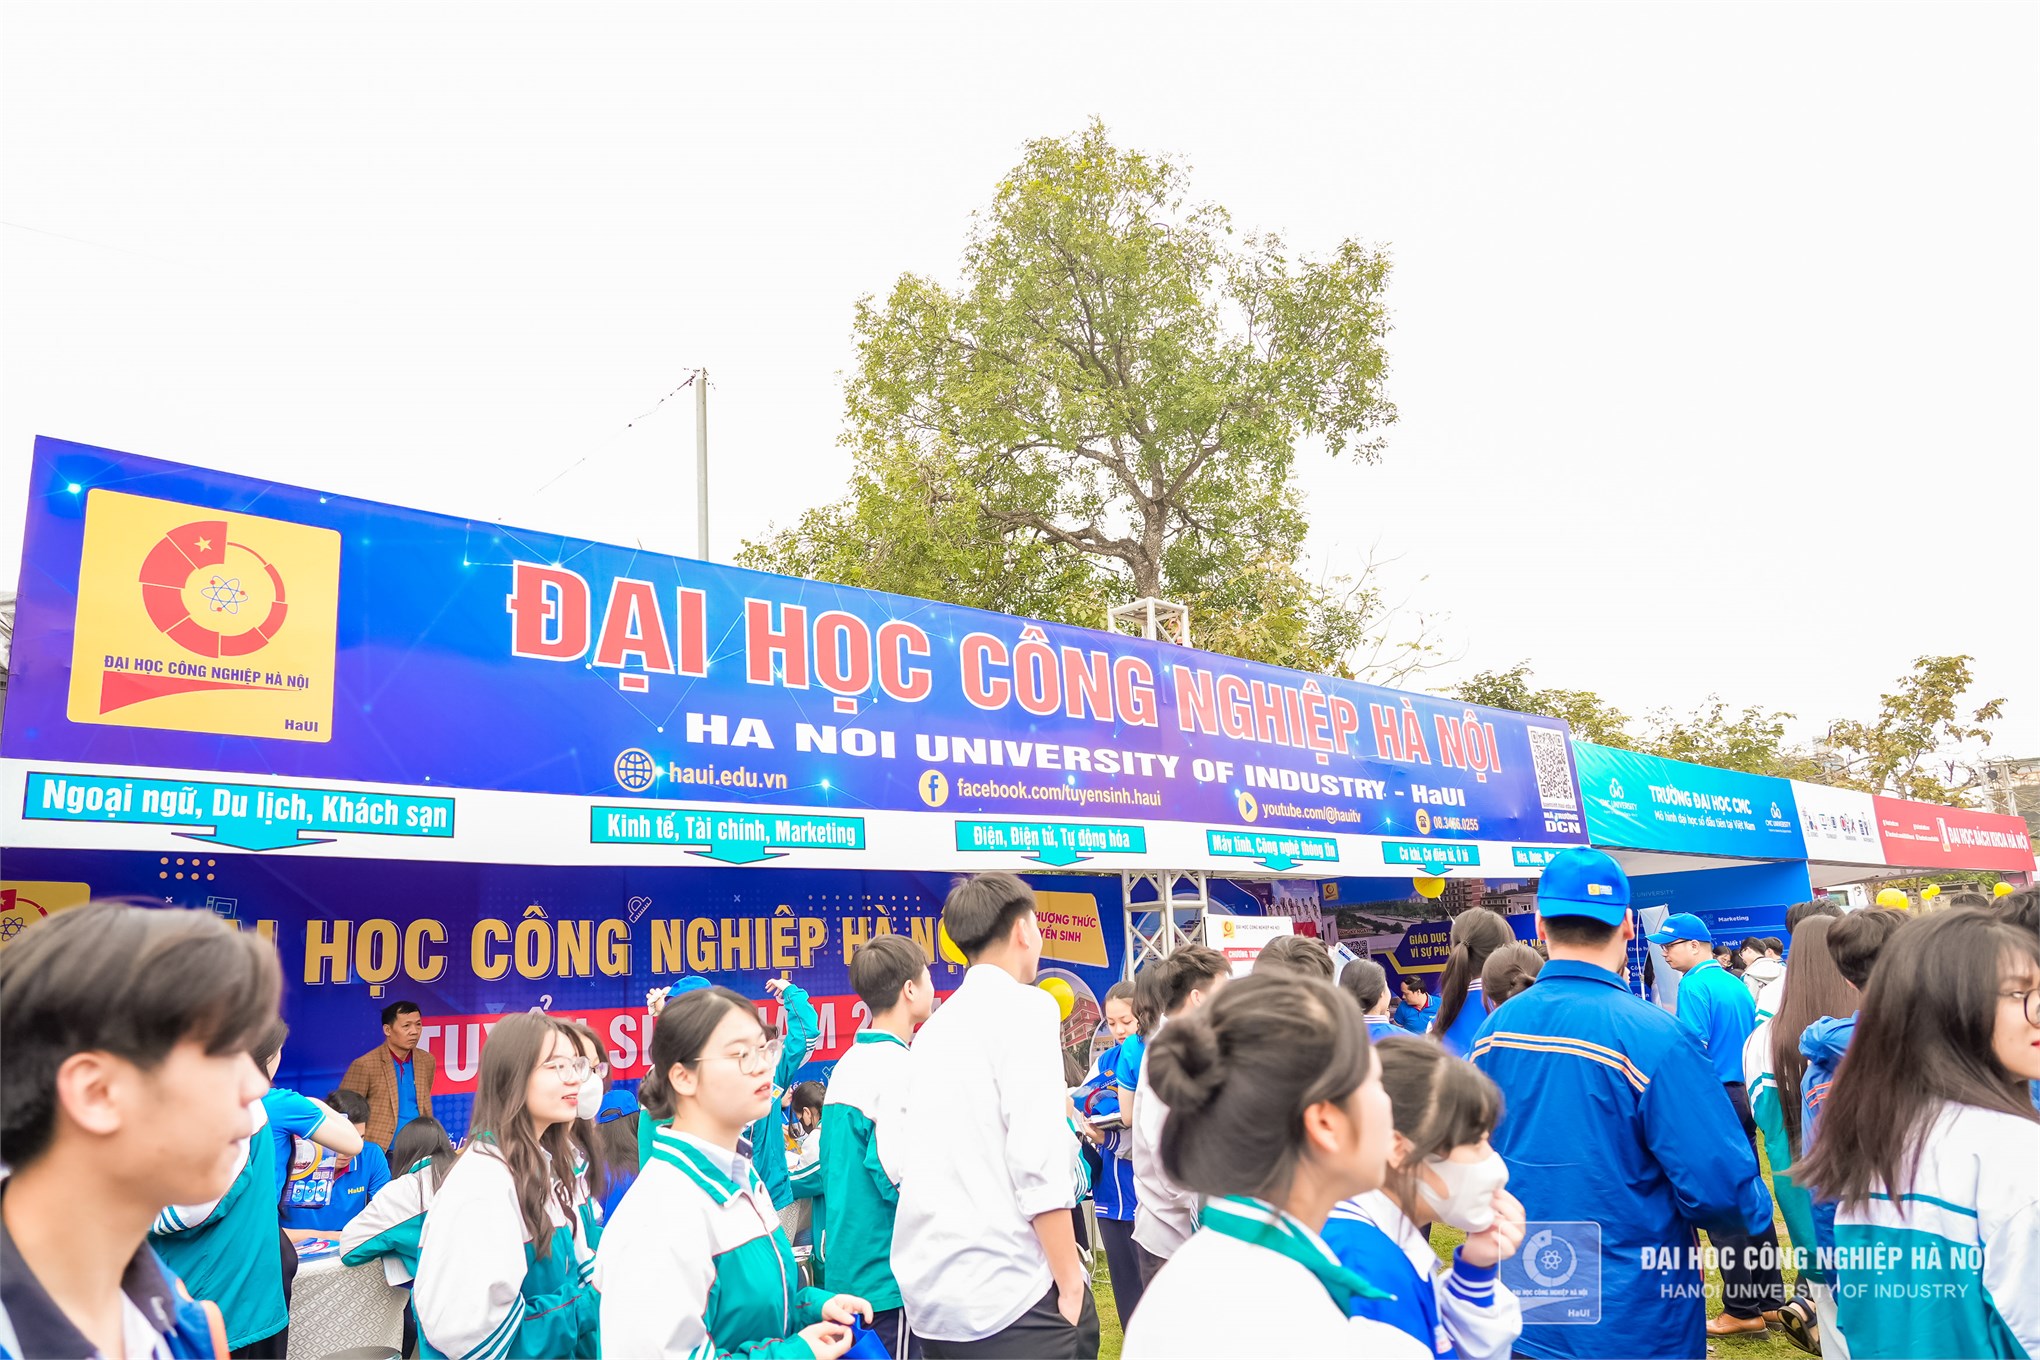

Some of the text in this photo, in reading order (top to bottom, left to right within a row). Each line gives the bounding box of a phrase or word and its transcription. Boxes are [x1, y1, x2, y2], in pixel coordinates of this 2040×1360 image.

[104, 655, 310, 691] ĐẠI HỌC CÔNG NGHIỆP HÀ NỘI
[506, 559, 1502, 783] ĐẠI HỌC CÔNG NGHIỆP HÀ NỘI
[284, 718, 319, 733] HaUI
[685, 712, 775, 750] HA
[795, 722, 896, 759] NOI
[915, 733, 1180, 779] UNIVERSITY
[1193, 758, 1234, 784] OF
[1244, 765, 1386, 800] INDUSTRY
[1411, 784, 1466, 807] HaUI
[669, 762, 788, 790] haui.edu.vn
[42, 778, 448, 833] Ngoại ngữ, Du lịch, Khách sạn
[957, 778, 1161, 807] facebook.com/tuyensinh.haui
[1648, 783, 1752, 815] TRƯỜNG ĐẠI HỌC CMC
[1262, 803, 1361, 824] youtube.com/@hauitv
[607, 811, 856, 848] Kinh tế, Tài chính, Marketing
[973, 826, 1008, 849] Điện,
[1010, 827, 1040, 850] Điện
[1060, 828, 1075, 851] Tự
[1078, 829, 1107, 851] động
[1109, 829, 1130, 848] hóa
[1544, 820, 1581, 834] DCN
[1637, 889, 1674, 897] UNIVERSITY
[1035, 911, 1097, 928] HƯƠNG THỨC
[1039, 924, 1082, 942] YỂN SINH
[1409, 932, 1447, 945] GIÁO DỤC
[303, 918, 449, 999] HỌC
[470, 904, 633, 980] CÔNG
[650, 903, 829, 981] NGHIỆP
[1410, 945, 1450, 960] VÌ SỰ PHÁ
